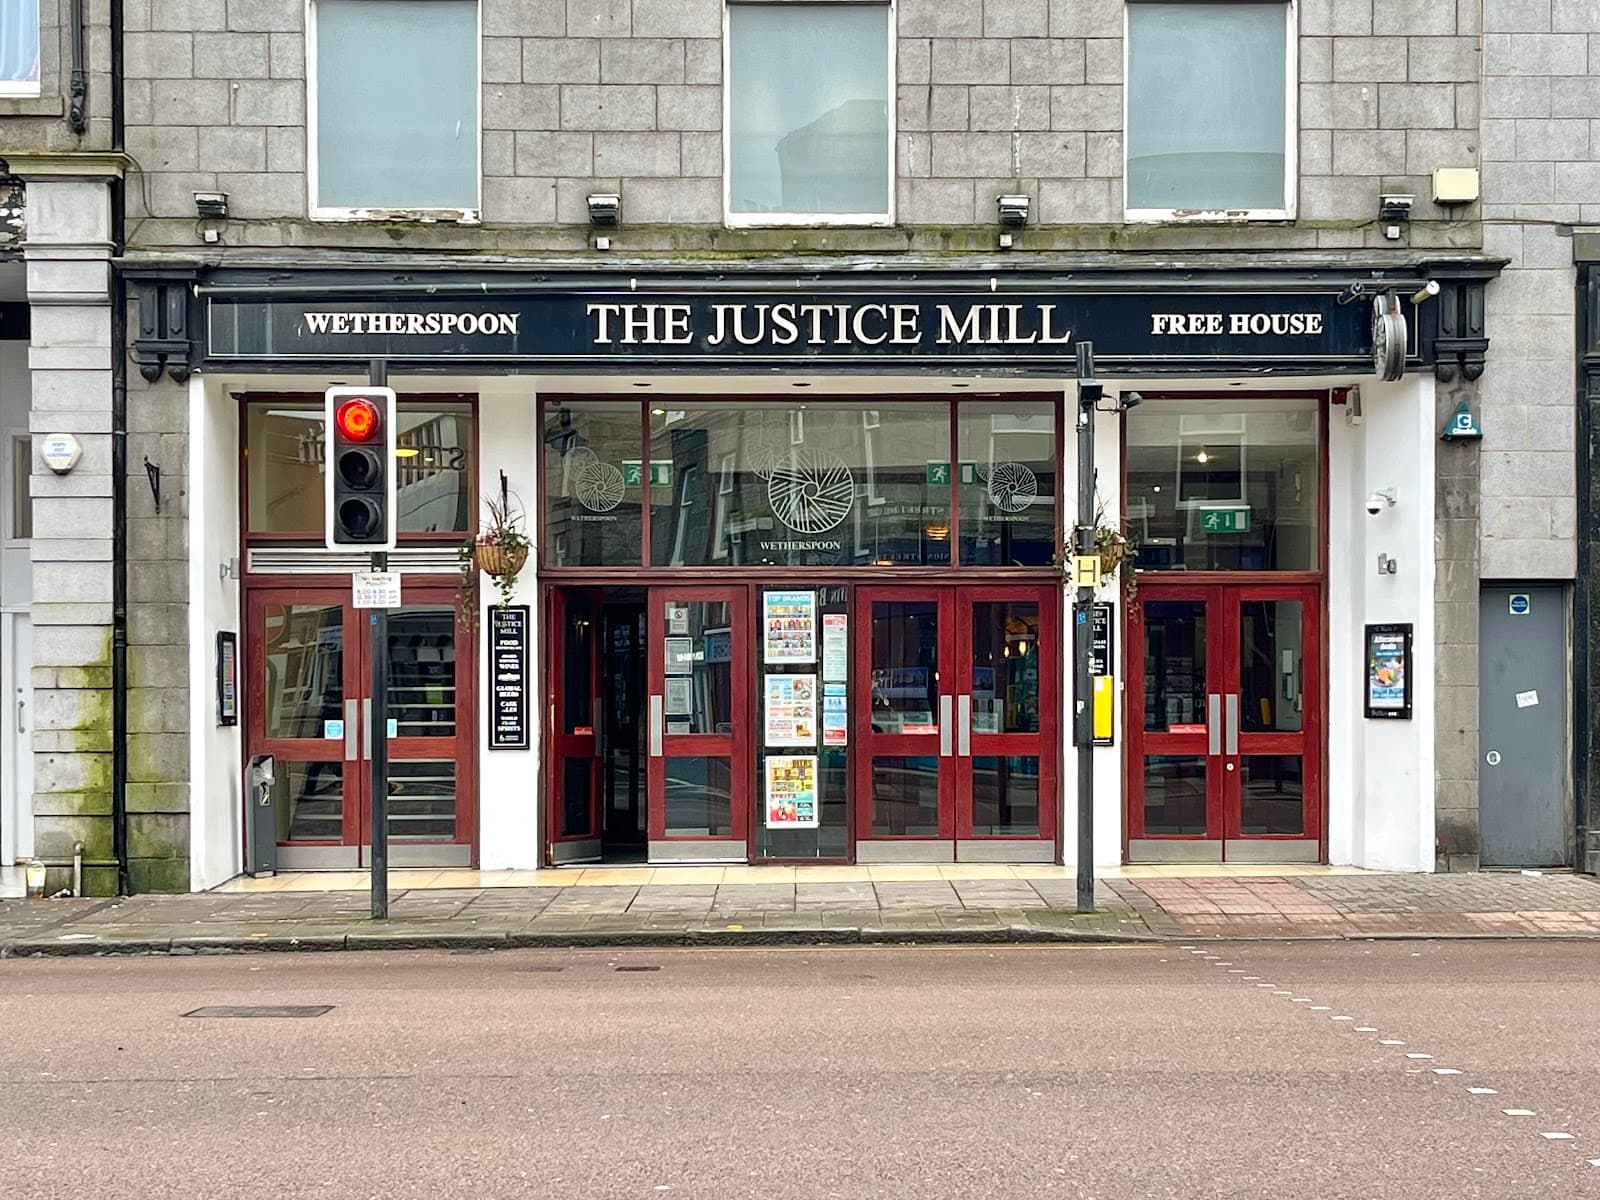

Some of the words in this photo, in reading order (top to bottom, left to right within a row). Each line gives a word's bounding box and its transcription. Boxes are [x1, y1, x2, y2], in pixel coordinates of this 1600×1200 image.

[303, 312, 515, 335] WETHERSPOON
[586, 303, 695, 345] THE
[706, 303, 923, 345] JUSTICE
[935, 304, 1072, 345] MILL
[1150, 313, 1224, 335] FREE
[1228, 313, 1323, 335] HOUSE
[760, 540, 841, 550] WETHERSPOON
[1077, 559, 1096, 583] H
